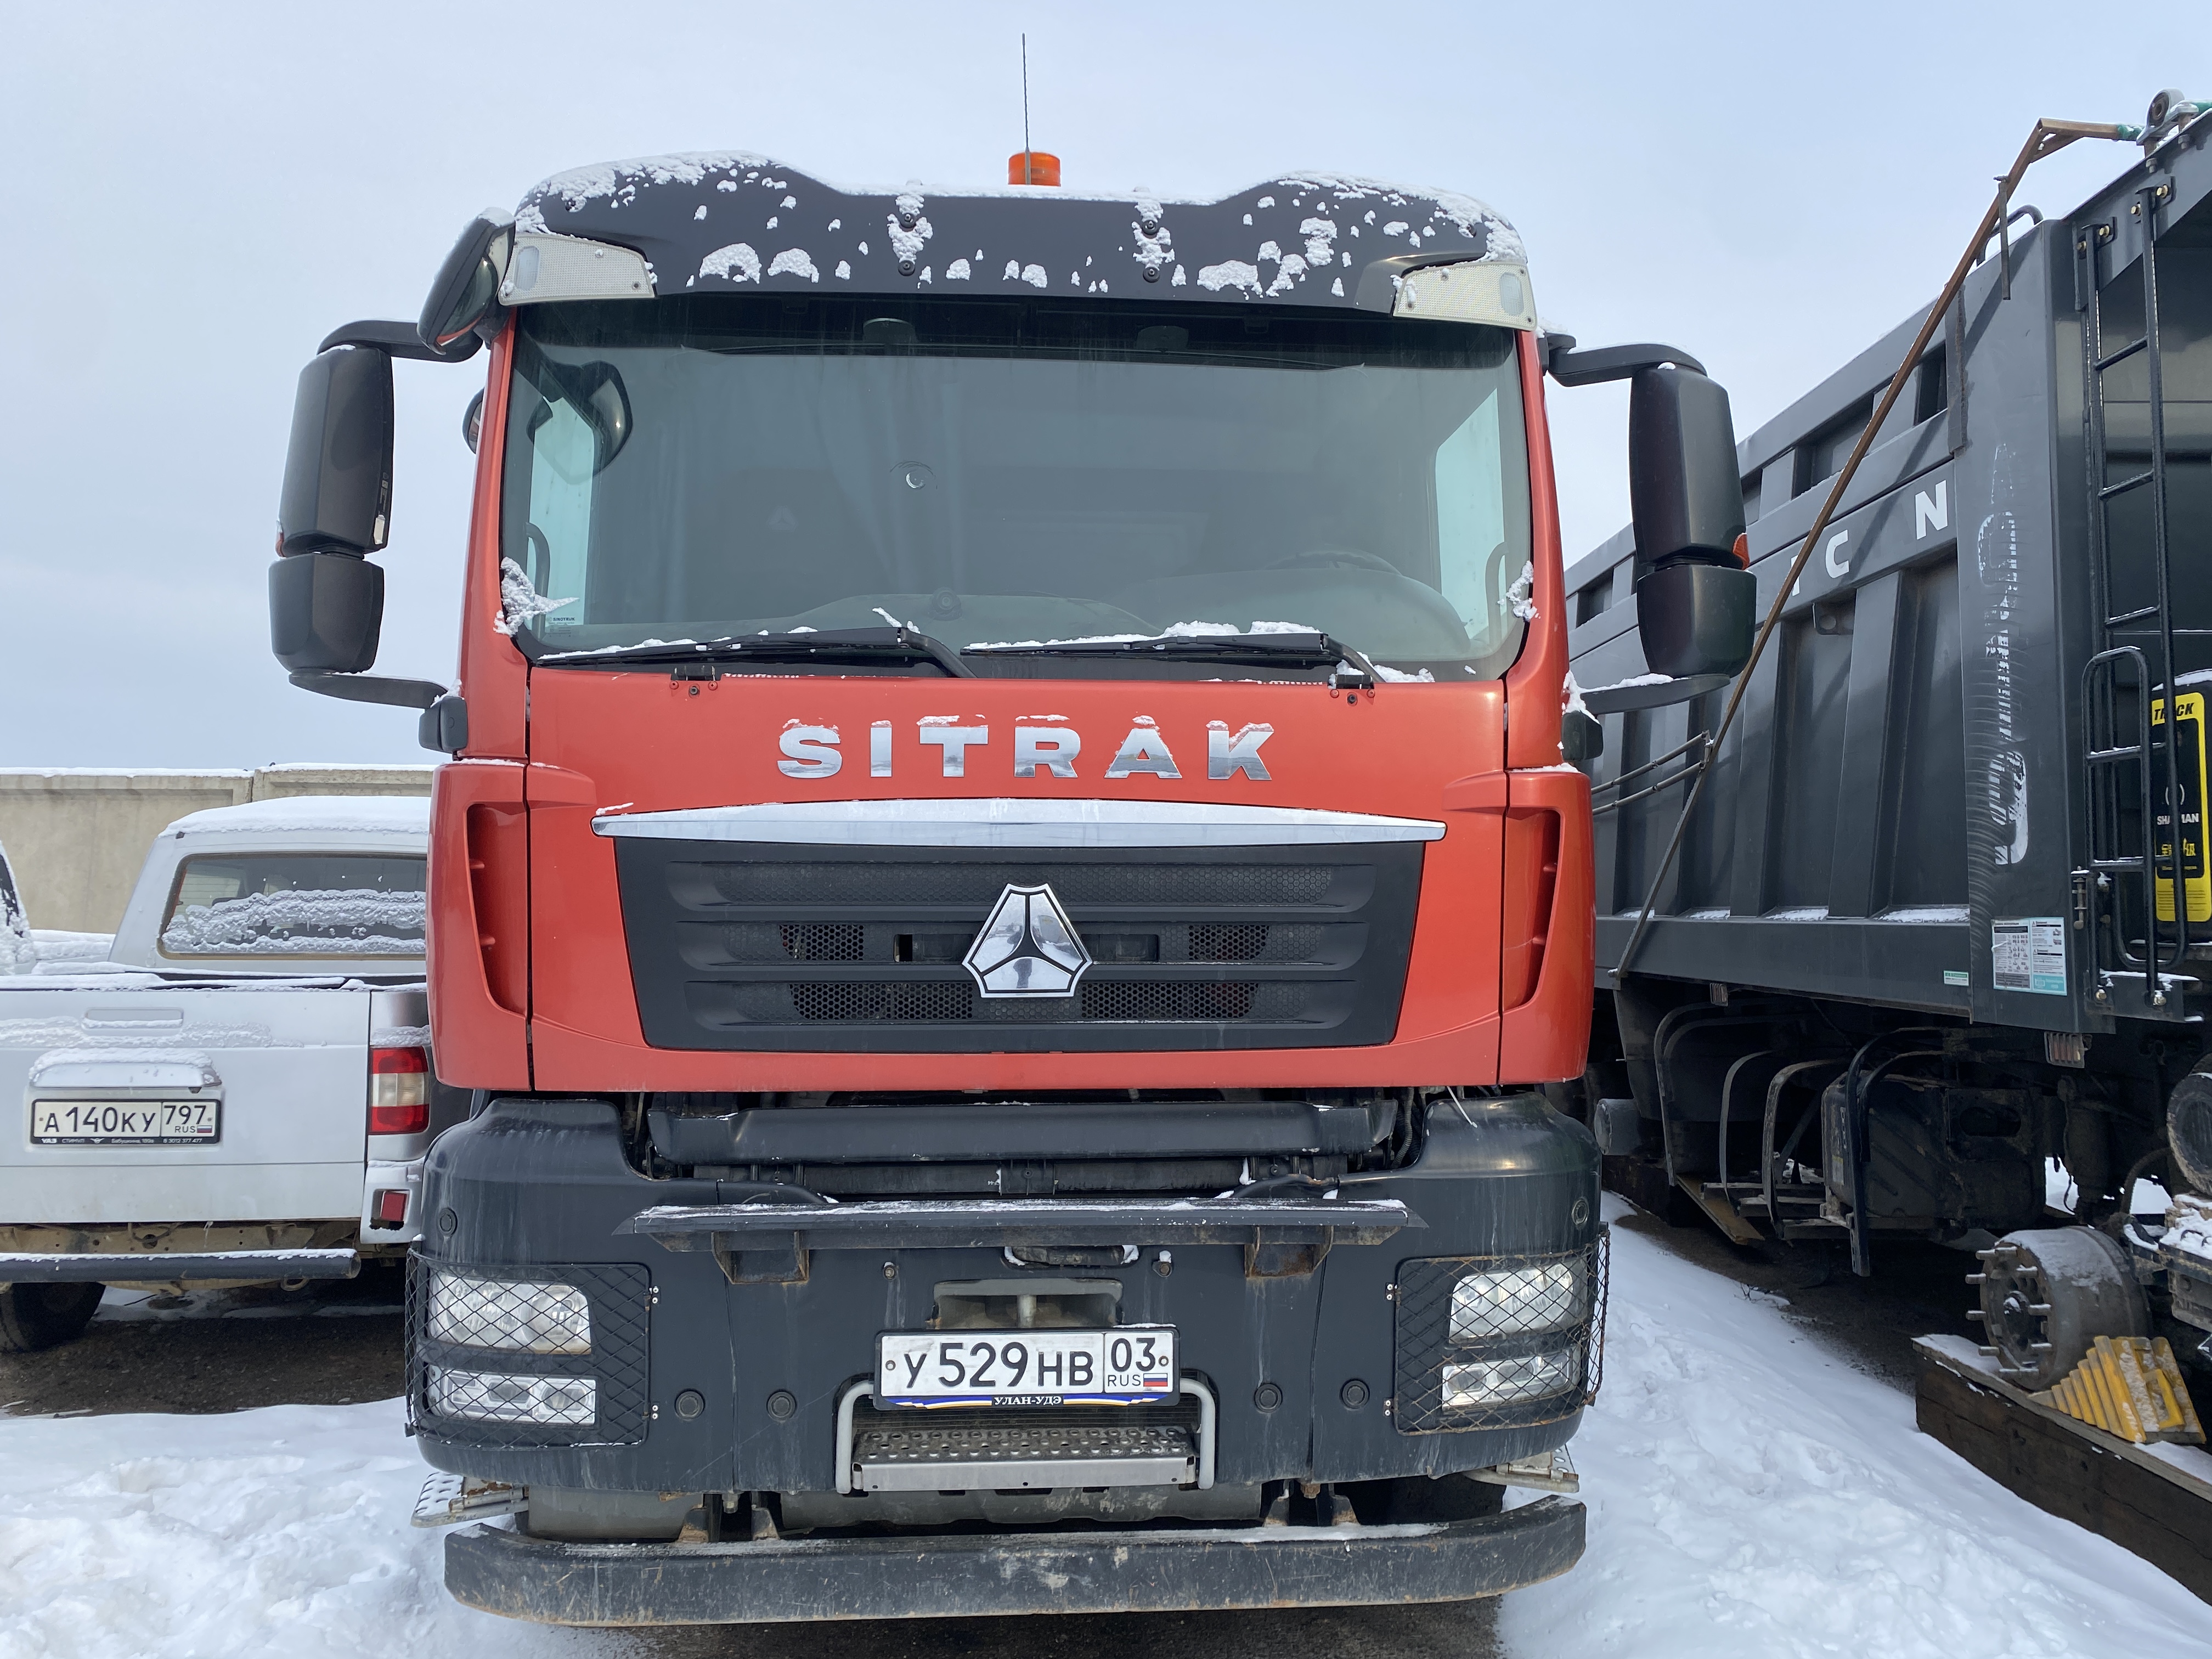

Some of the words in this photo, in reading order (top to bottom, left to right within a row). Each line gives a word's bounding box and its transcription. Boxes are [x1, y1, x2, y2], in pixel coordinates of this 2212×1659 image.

[2154, 703, 2194, 720] TCK
[777, 726, 1274, 780] SITRAK
[2157, 813, 2199, 825] SHAN
[44, 1107, 156, 1132] А140КУ
[164, 1105, 206, 1125] 797
[904, 1341, 1094, 1389] У529НВ
[1110, 1337, 1156, 1372] 03
[1107, 1374, 1142, 1387] RUS
[994, 1396, 1062, 1406] УЛАН-УДЭ
